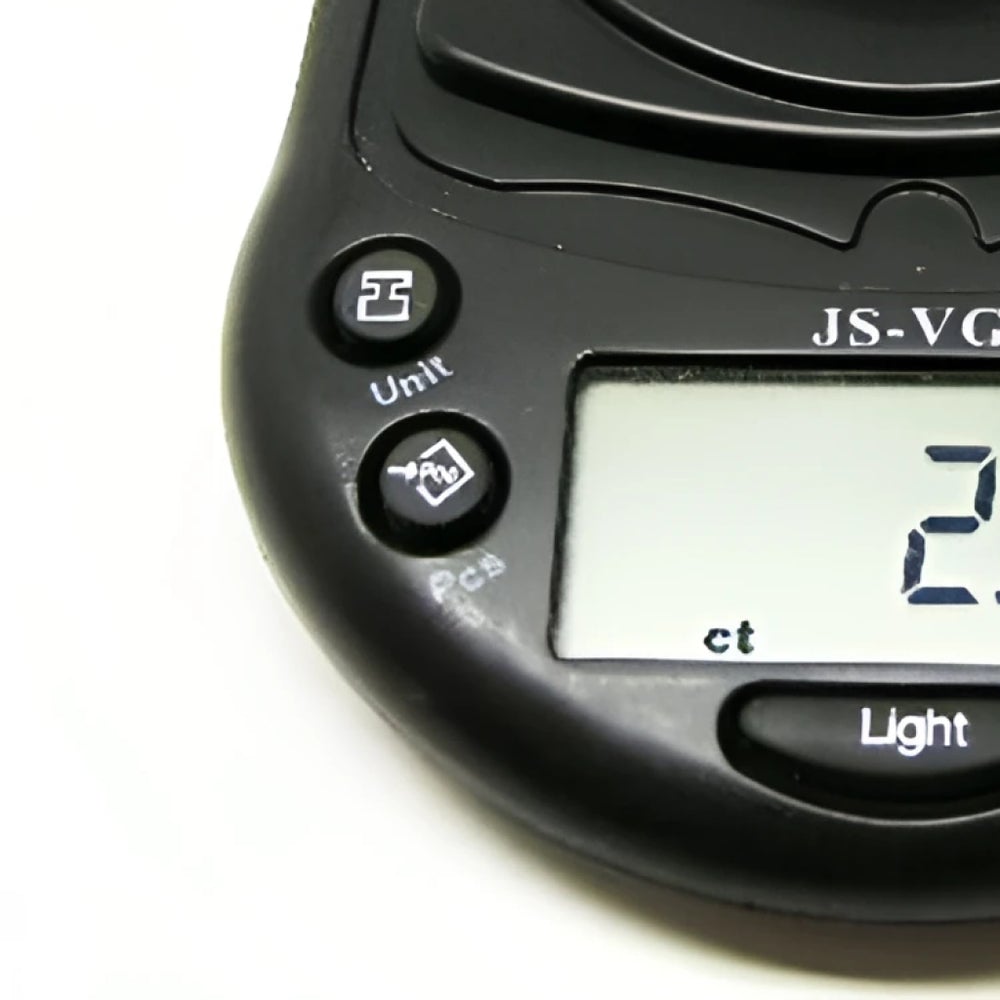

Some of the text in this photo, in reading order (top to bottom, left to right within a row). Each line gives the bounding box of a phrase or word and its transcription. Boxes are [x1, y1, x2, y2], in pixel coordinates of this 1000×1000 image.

[369, 355, 455, 406] Unit
[703, 619, 755, 654] ct
[860, 706, 968, 756] Light
